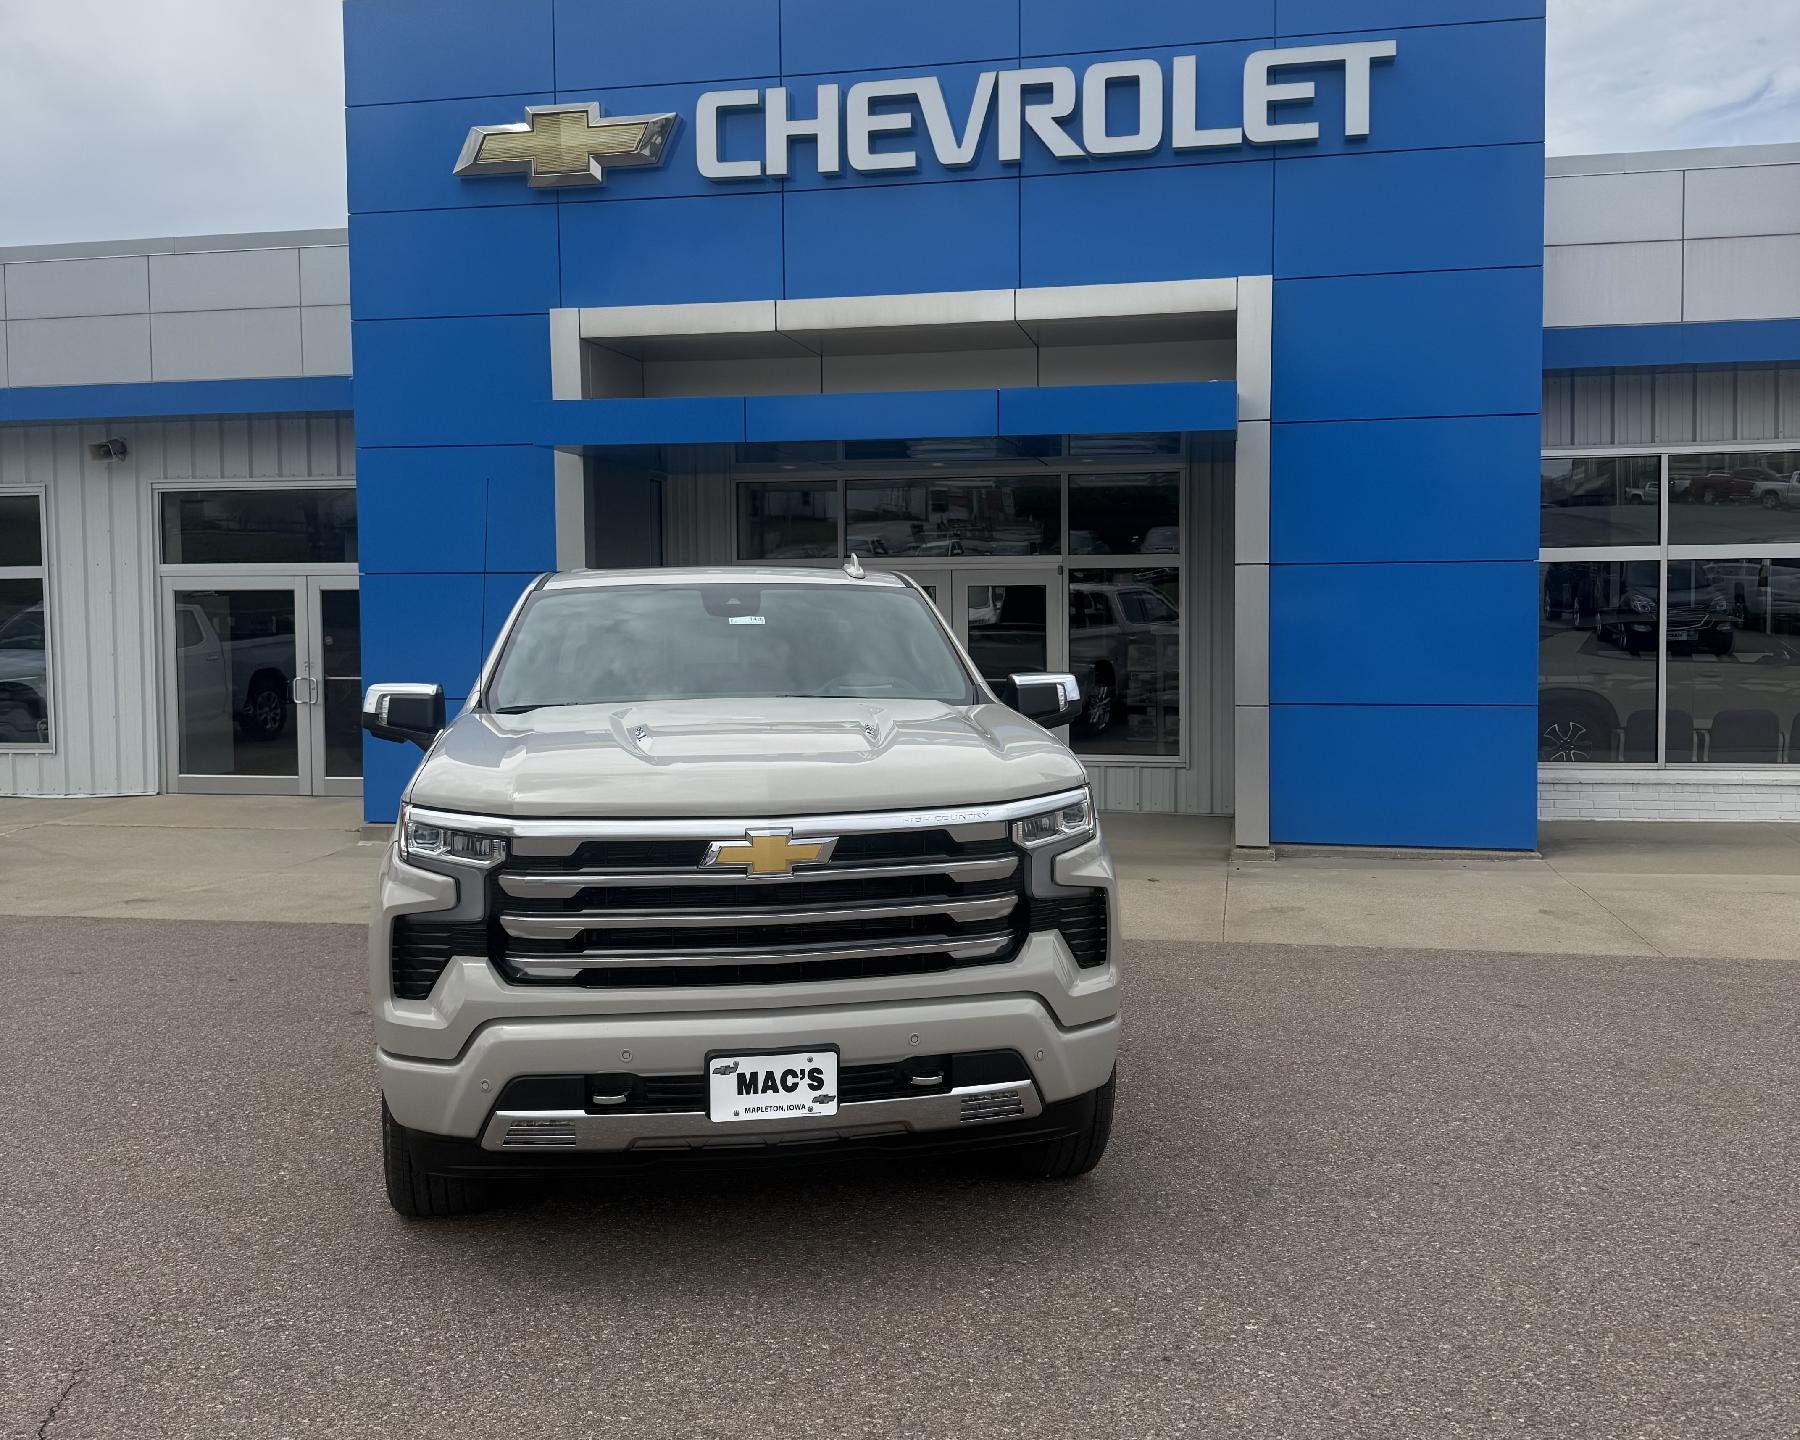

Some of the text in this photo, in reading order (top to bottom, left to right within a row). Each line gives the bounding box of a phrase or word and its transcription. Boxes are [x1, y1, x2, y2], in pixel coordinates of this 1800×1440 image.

[695, 39, 1398, 180] CHEVROLET
[737, 1067, 825, 1095] MAC'S
[744, 1103, 806, 1114] MAPLETON, IOWA
